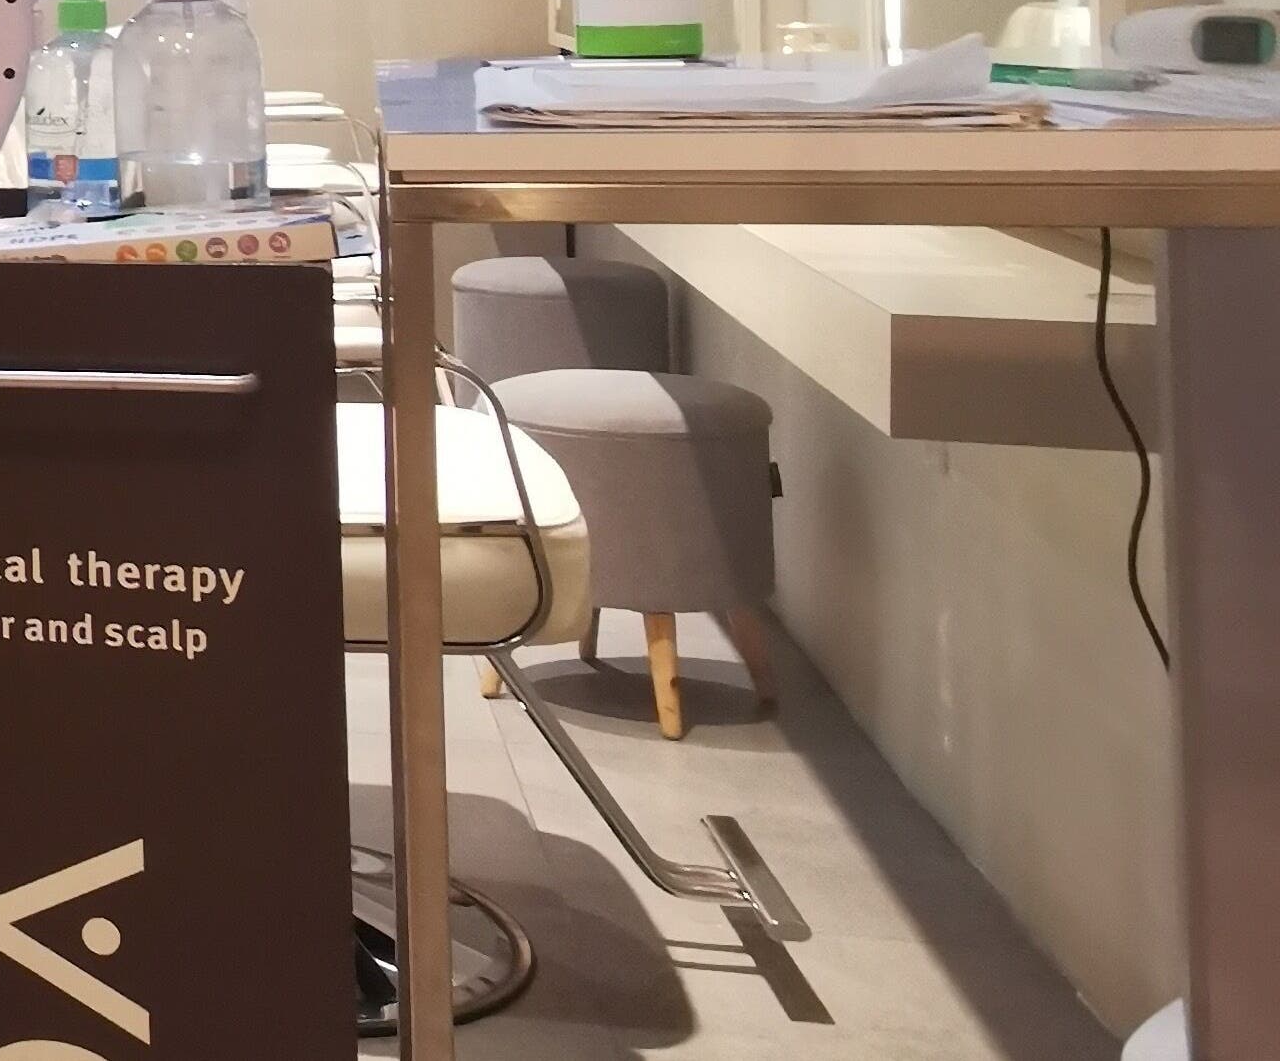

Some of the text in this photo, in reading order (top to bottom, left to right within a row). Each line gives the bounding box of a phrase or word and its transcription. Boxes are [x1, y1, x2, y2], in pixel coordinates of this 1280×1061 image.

[68, 550, 246, 605] therapy
[24, 612, 93, 646] and
[104, 618, 208, 660] scalp
